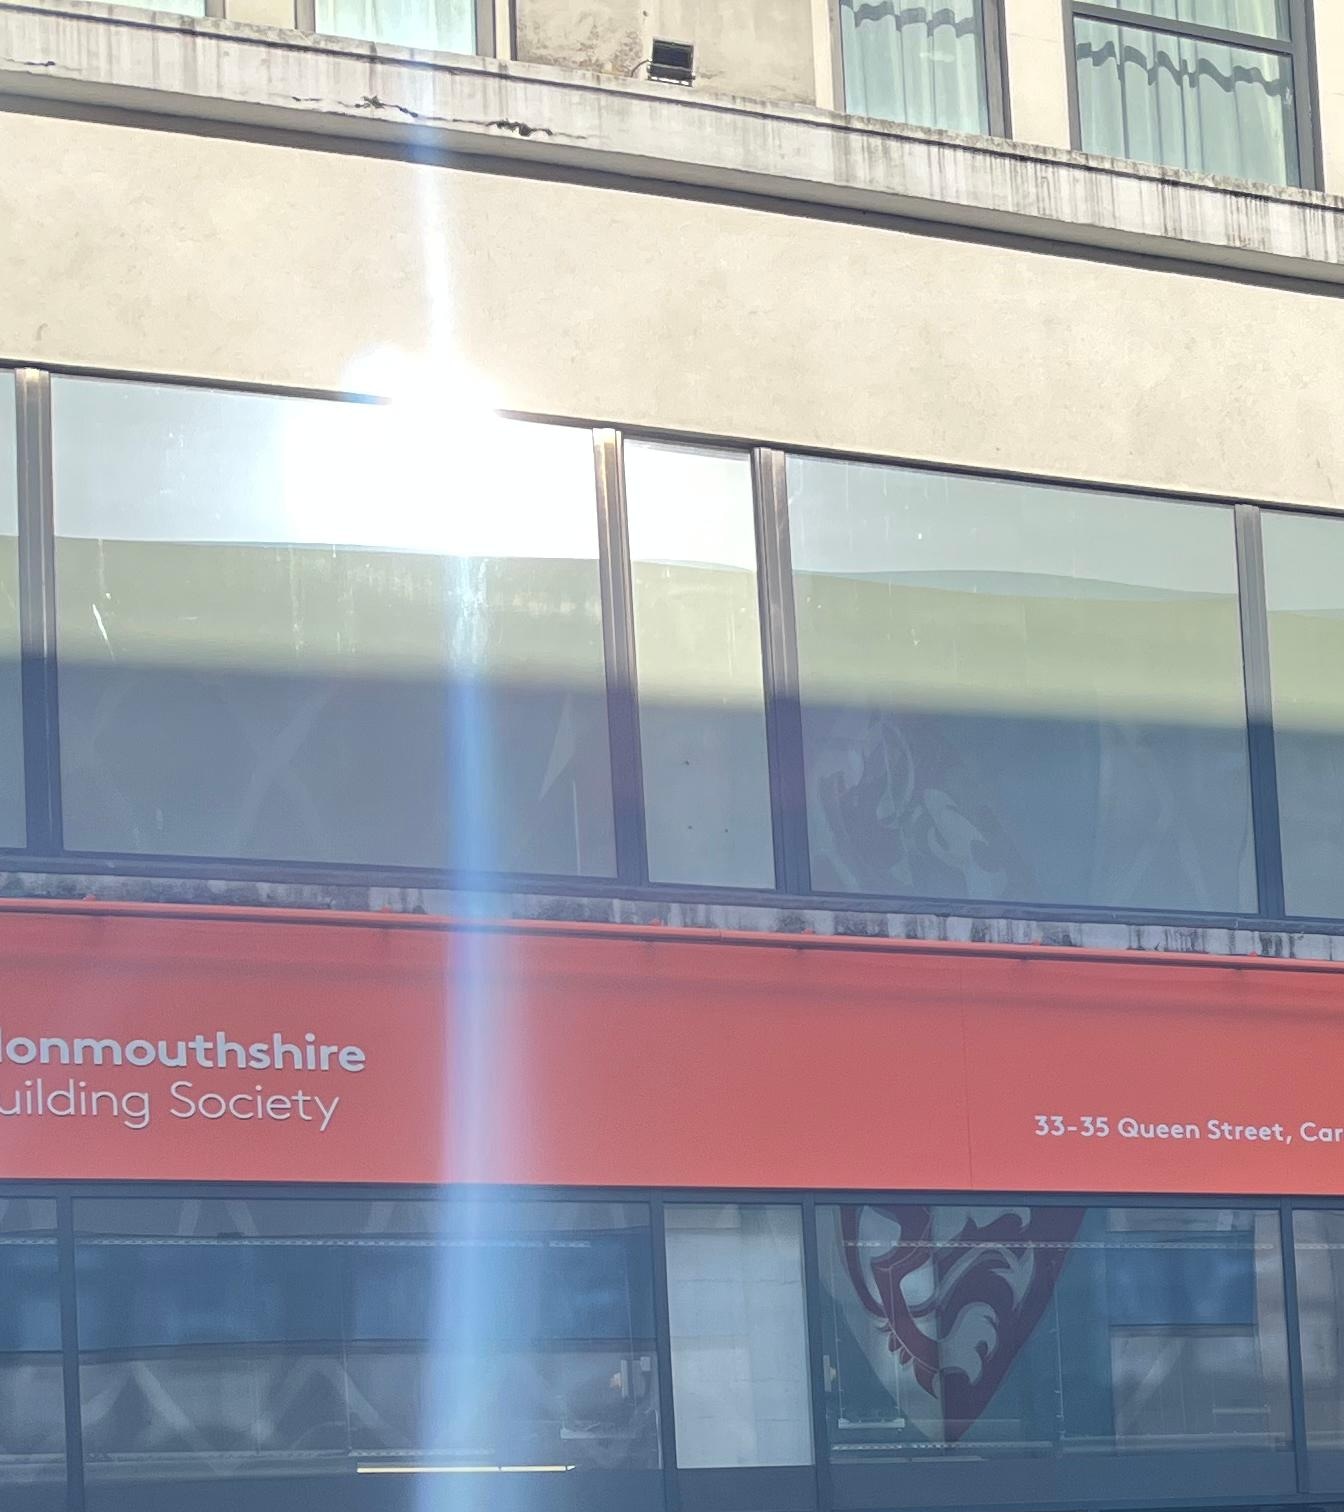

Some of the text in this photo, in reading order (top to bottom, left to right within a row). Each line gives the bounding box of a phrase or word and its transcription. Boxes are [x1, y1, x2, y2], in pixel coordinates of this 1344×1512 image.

[0, 1029, 366, 1072] onmouthshire
[0, 1077, 340, 1131] uilding Society
[1034, 1115, 1110, 1137] 33-35
[1118, 1117, 1200, 1139] Queen
[1207, 1119, 1292, 1145] Street,
